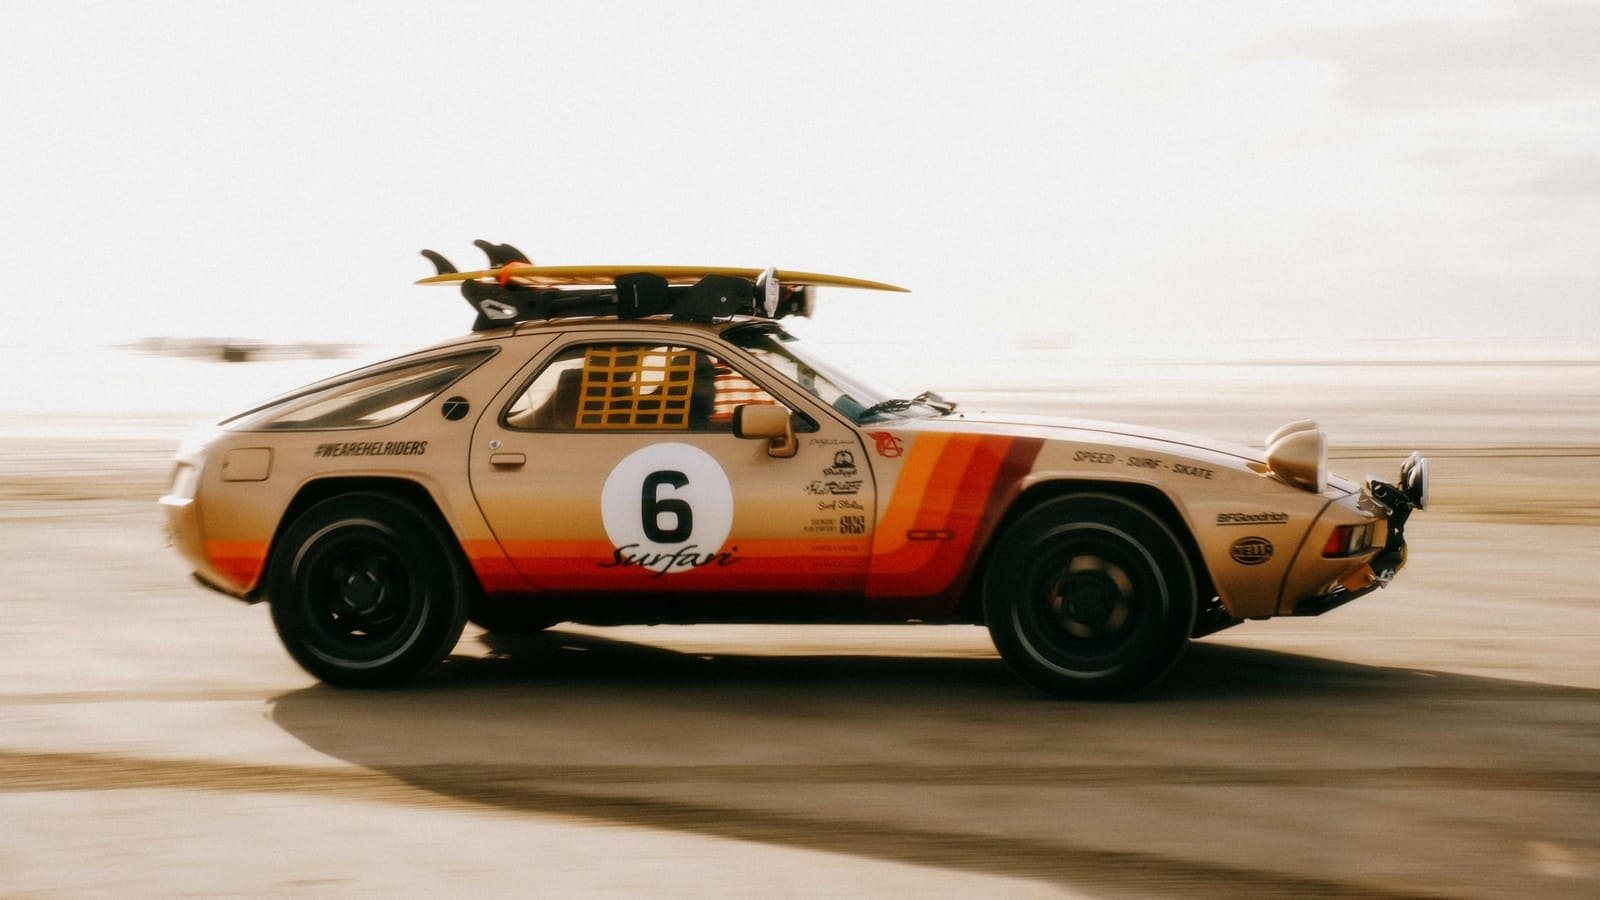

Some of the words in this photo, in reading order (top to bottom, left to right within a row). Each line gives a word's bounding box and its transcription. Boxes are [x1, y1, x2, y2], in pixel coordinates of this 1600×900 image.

[313, 441, 428, 457] #WEAREHELRIDERS
[1073, 451, 1117, 465] SPEED
[1127, 456, 1161, 470] SURF
[1172, 463, 1215, 480] SKATE
[641, 470, 693, 544] 6
[1216, 512, 1289, 522] BFGoodrich
[598, 544, 741, 579] Surfari
